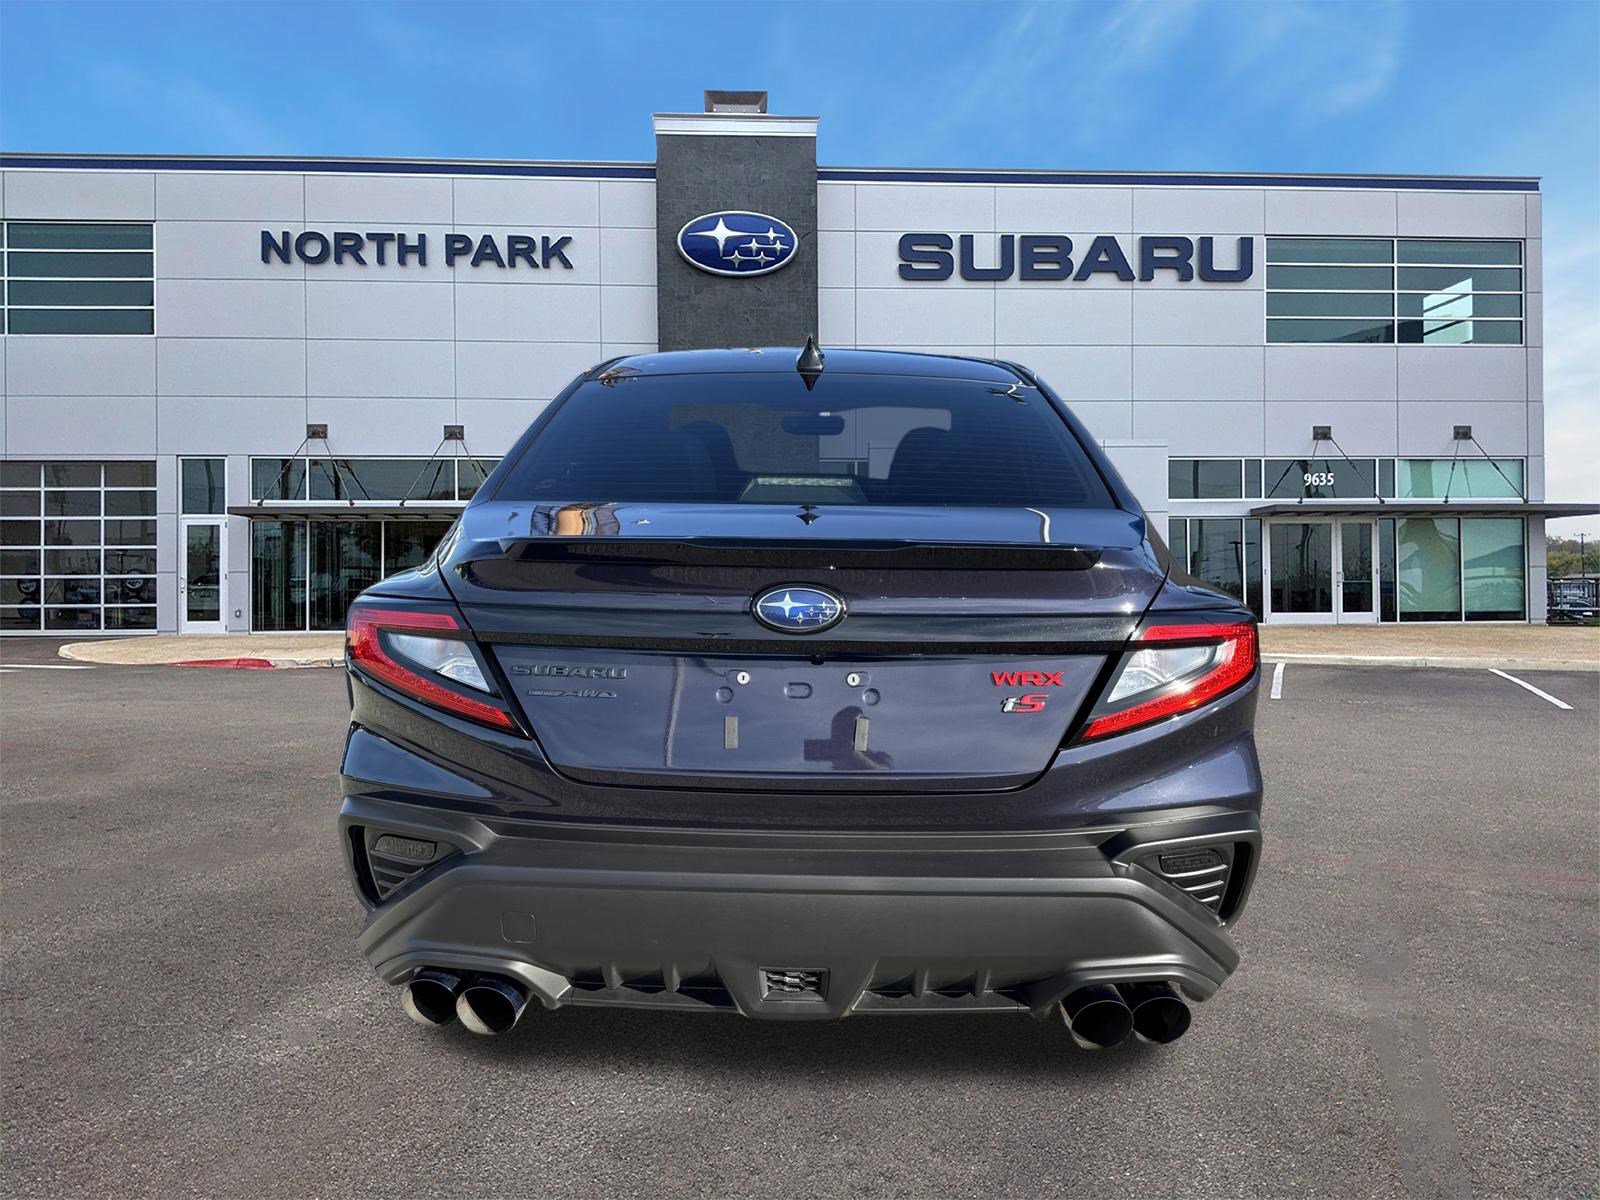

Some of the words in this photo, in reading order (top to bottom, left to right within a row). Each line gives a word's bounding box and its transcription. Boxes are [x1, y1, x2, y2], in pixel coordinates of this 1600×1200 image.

[260, 230, 428, 267] NORTH
[444, 232, 575, 270] PARK
[897, 232, 1255, 283] SUBARU
[1303, 472, 1335, 487] 9635
[510, 663, 627, 680] SUBARU
[990, 671, 1064, 687] WRX
